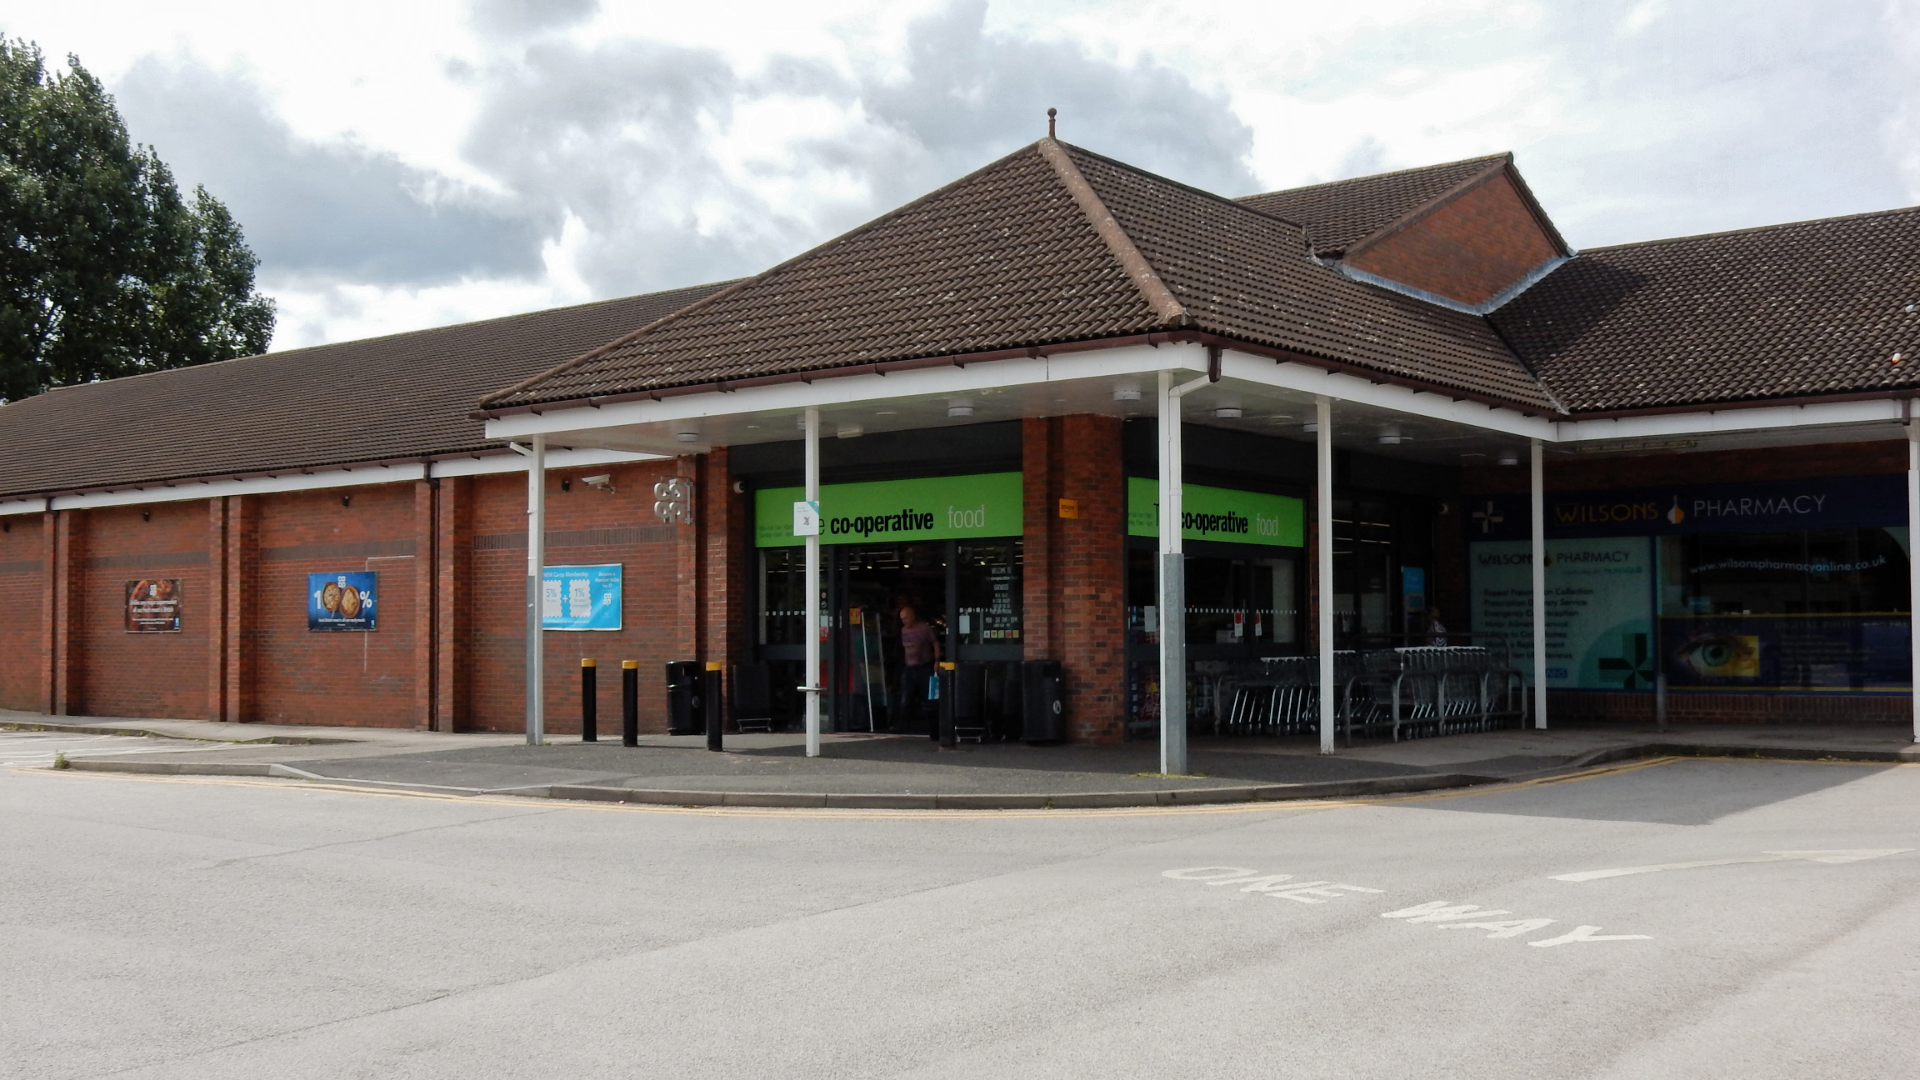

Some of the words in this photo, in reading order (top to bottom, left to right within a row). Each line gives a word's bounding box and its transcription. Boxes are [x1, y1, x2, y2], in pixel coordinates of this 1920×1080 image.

[947, 504, 986, 529] food
[1557, 503, 1658, 523] WILSONS
[1693, 495, 1826, 517] PHARMACY
[1256, 513, 1279, 536] food
[1478, 553, 1533, 565] WILSON
[1557, 551, 1630, 563] PHARMACY
[1690, 555, 1887, 574] www.wilsonspharmacyonline.co.uk
[546, 588, 557, 598] 5%
[574, 588, 585, 597] 1%
[1556, 588, 1593, 596] Collection
[1484, 599, 1527, 608] Prescription
[1560, 598, 1587, 606] Service
[1484, 609, 1525, 619] Emergency
[1161, 865, 1386, 906] ONE
[1380, 899, 1654, 949] WAY
